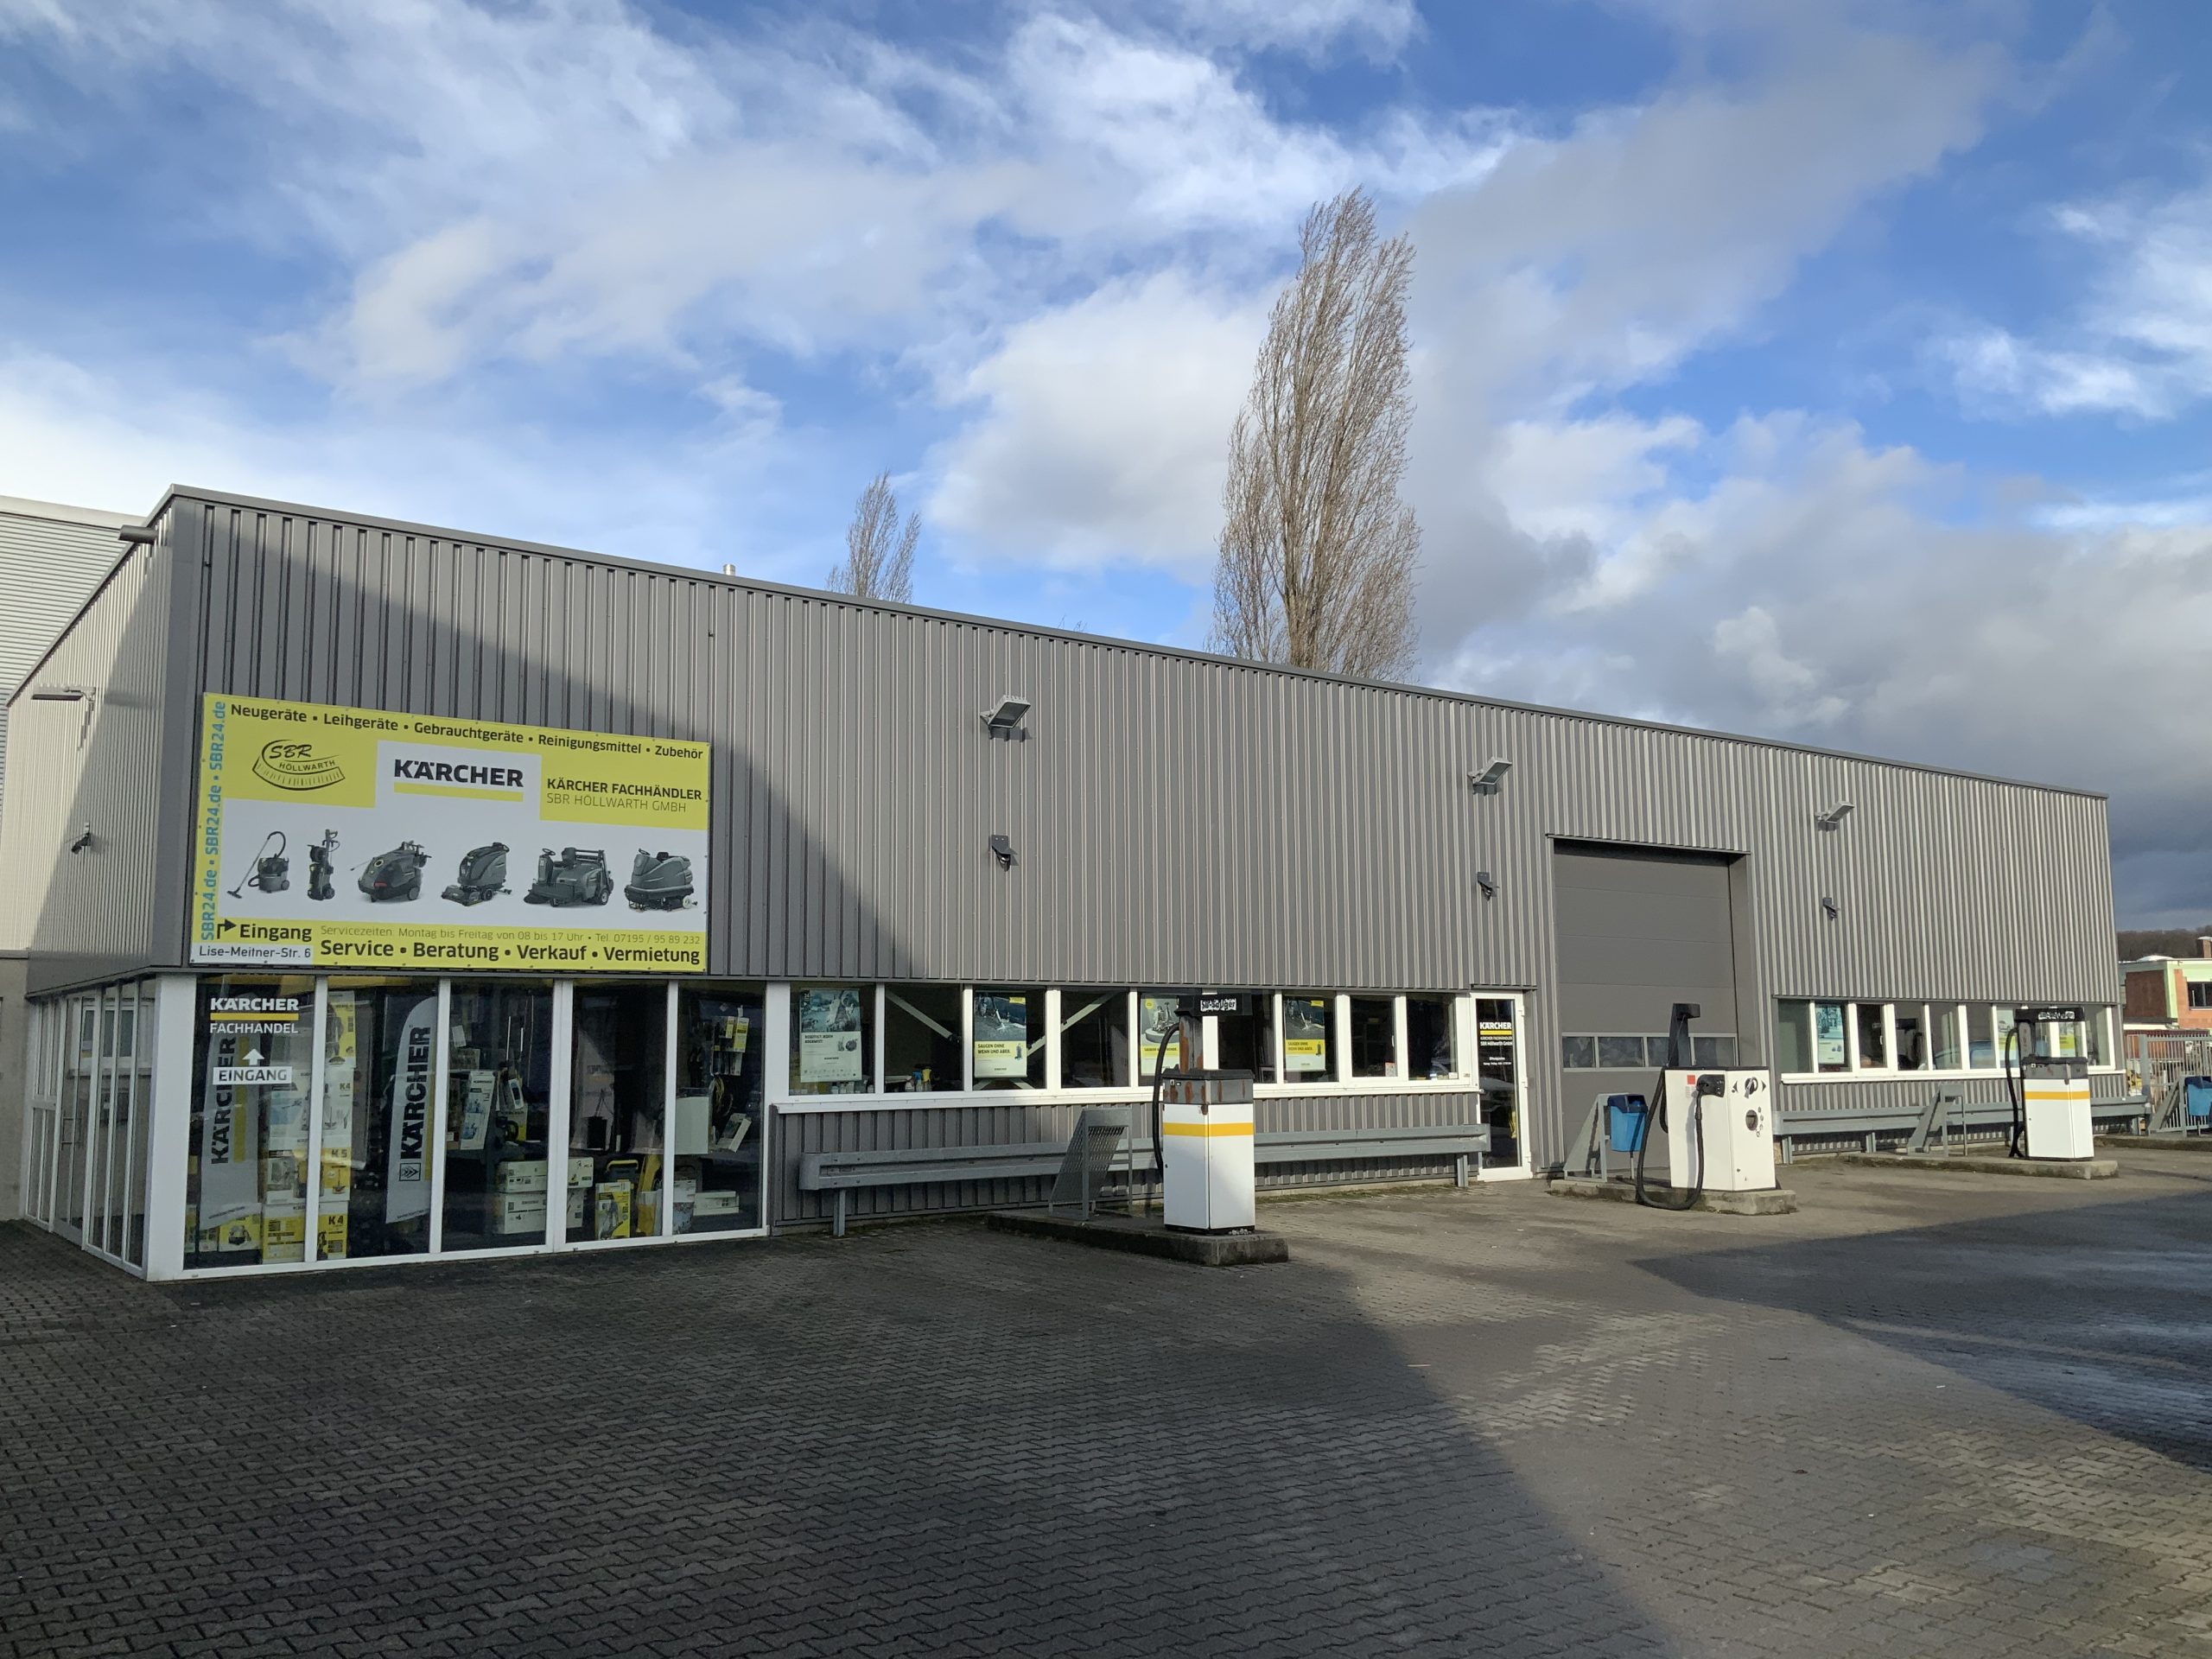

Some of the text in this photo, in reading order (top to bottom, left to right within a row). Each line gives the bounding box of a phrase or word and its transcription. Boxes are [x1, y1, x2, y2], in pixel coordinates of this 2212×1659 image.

[231, 703, 703, 760] Neugeräte Leihgeräte Gebrauchtgeräte Reinigungsmittel Zubehör
[269, 744, 312, 759] SBR
[394, 759, 524, 787] KÄRCHER
[547, 777, 702, 800] KÄRCHER FACHHÄNDLER
[546, 792, 570, 804] SBR
[652, 800, 686, 812] GMBH
[201, 701, 226, 941] SBR24.de SBR24.de SBR24.de
[239, 924, 312, 942] Eingang
[321, 925, 392, 937] Servicezeiten
[398, 928, 437, 939] Montag
[440, 929, 455, 938] bis
[458, 929, 493, 941] Freitag
[518, 931, 531, 940] 08
[534, 931, 548, 941] bis
[551, 932, 563, 941] 17
[566, 932, 582, 942] Uhr
[613, 933, 645, 944] 07195
[653, 934, 666, 944] 95
[668, 935, 680, 944] 89
[683, 936, 700, 944] 232
[304, 948, 311, 958] 6
[321, 939, 700, 964] Service Beratung Verkauf Vermietung
[210, 997, 299, 1012] KÄRCHER
[210, 1022, 299, 1034] FACHHANDEL
[218, 1069, 288, 1082] EINGANG
[211, 1037, 236, 1164] KÄRCER
[400, 1027, 430, 1160] KÄRCHER
